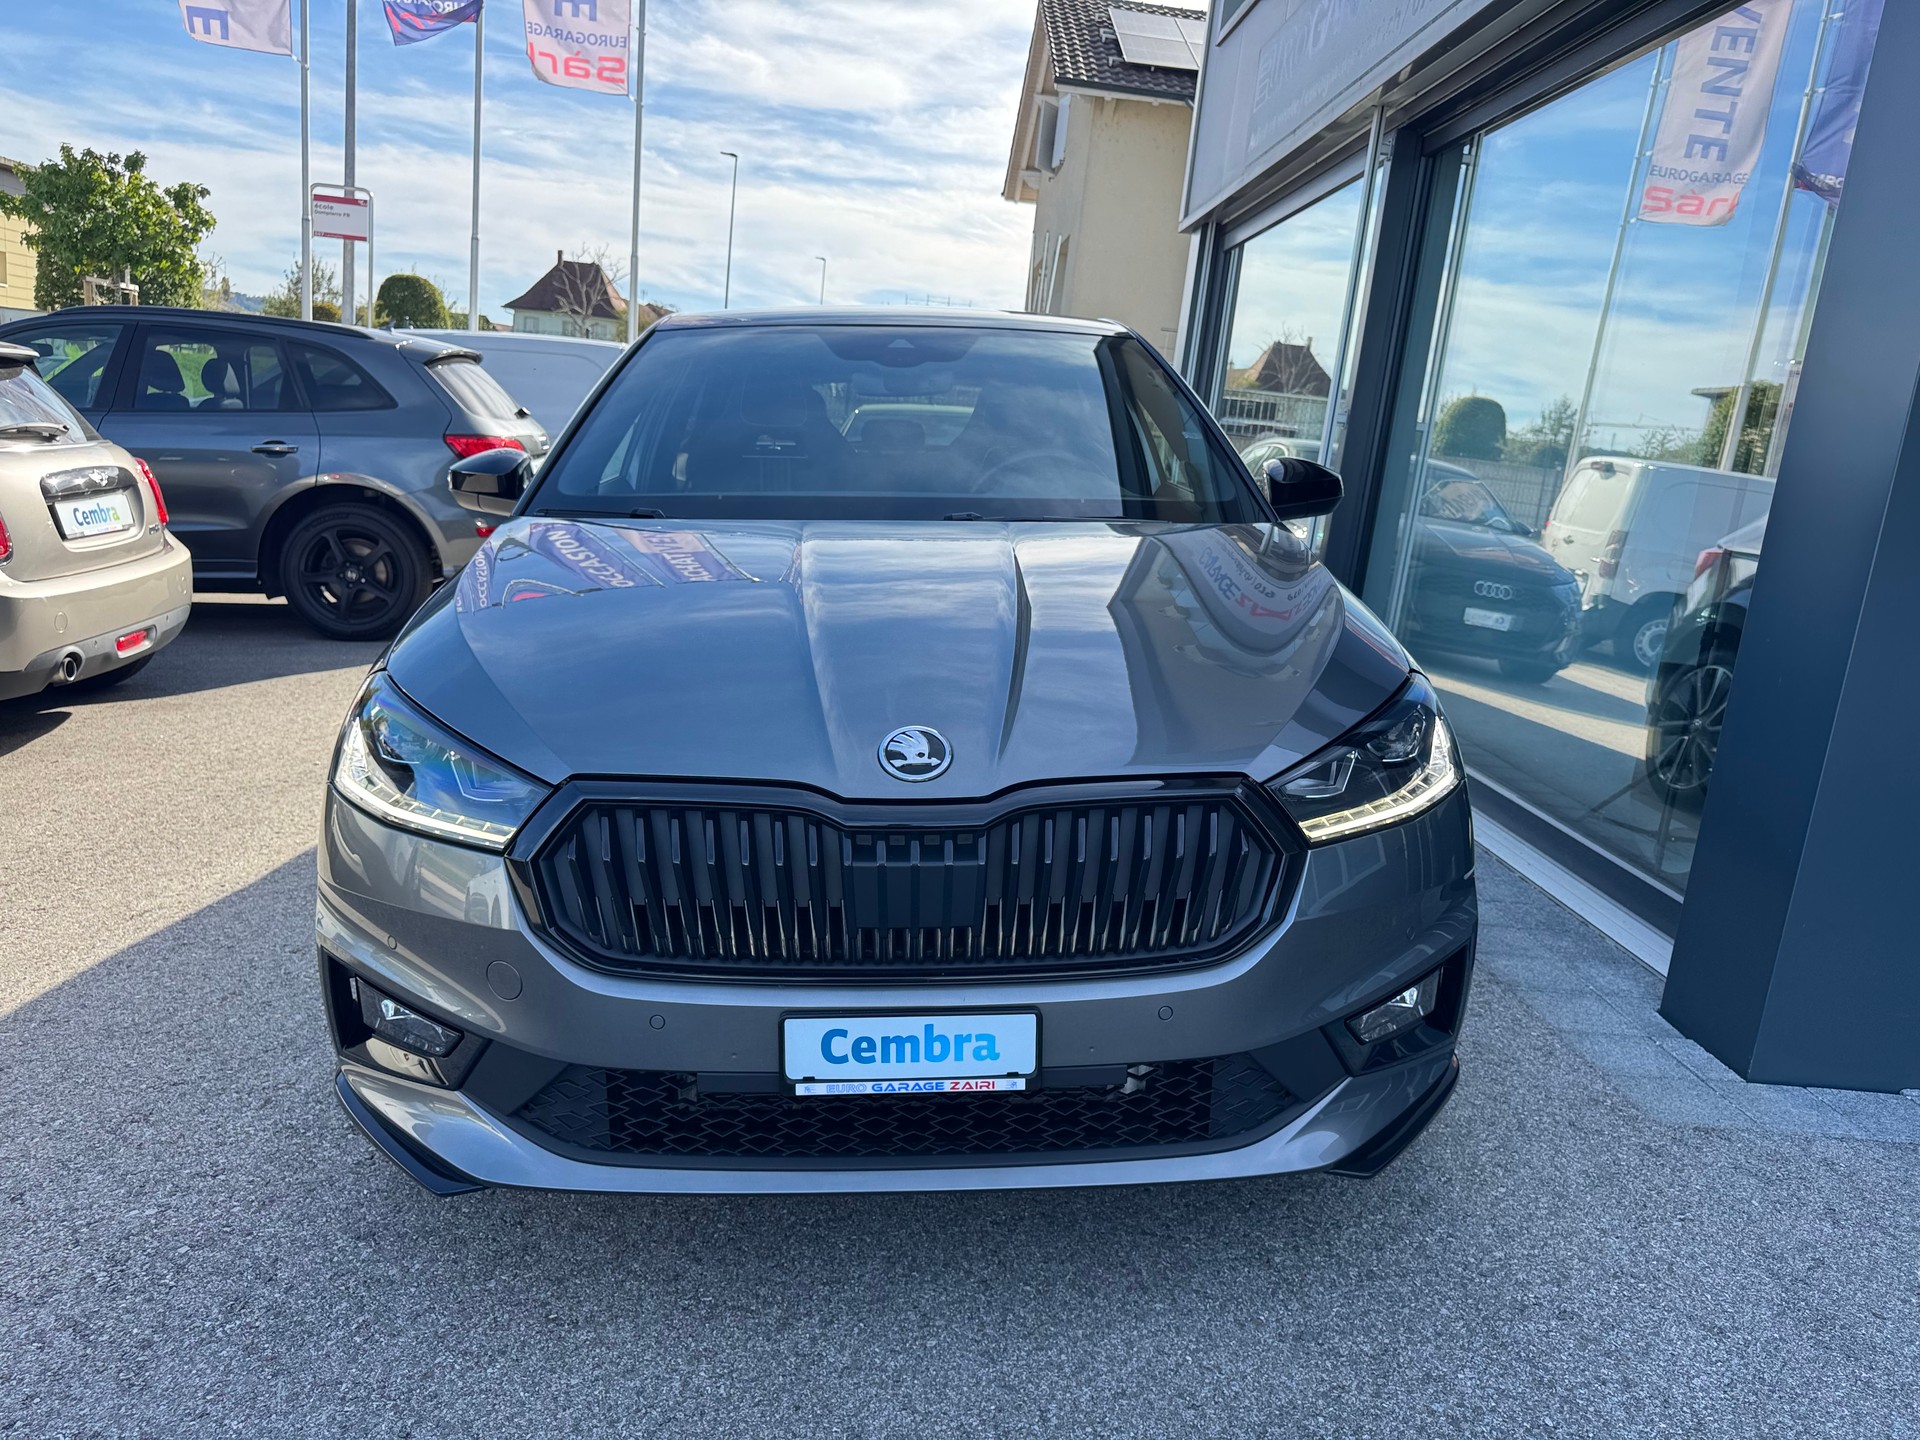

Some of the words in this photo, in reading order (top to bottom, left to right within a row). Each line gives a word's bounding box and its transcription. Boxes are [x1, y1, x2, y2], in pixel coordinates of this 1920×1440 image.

[73, 503, 120, 526] Cembra
[820, 1023, 1001, 1065] Cembra
[826, 1083, 868, 1094] EURO
[871, 1081, 945, 1092] GARAGE
[949, 1080, 996, 1091] ZAIRI
